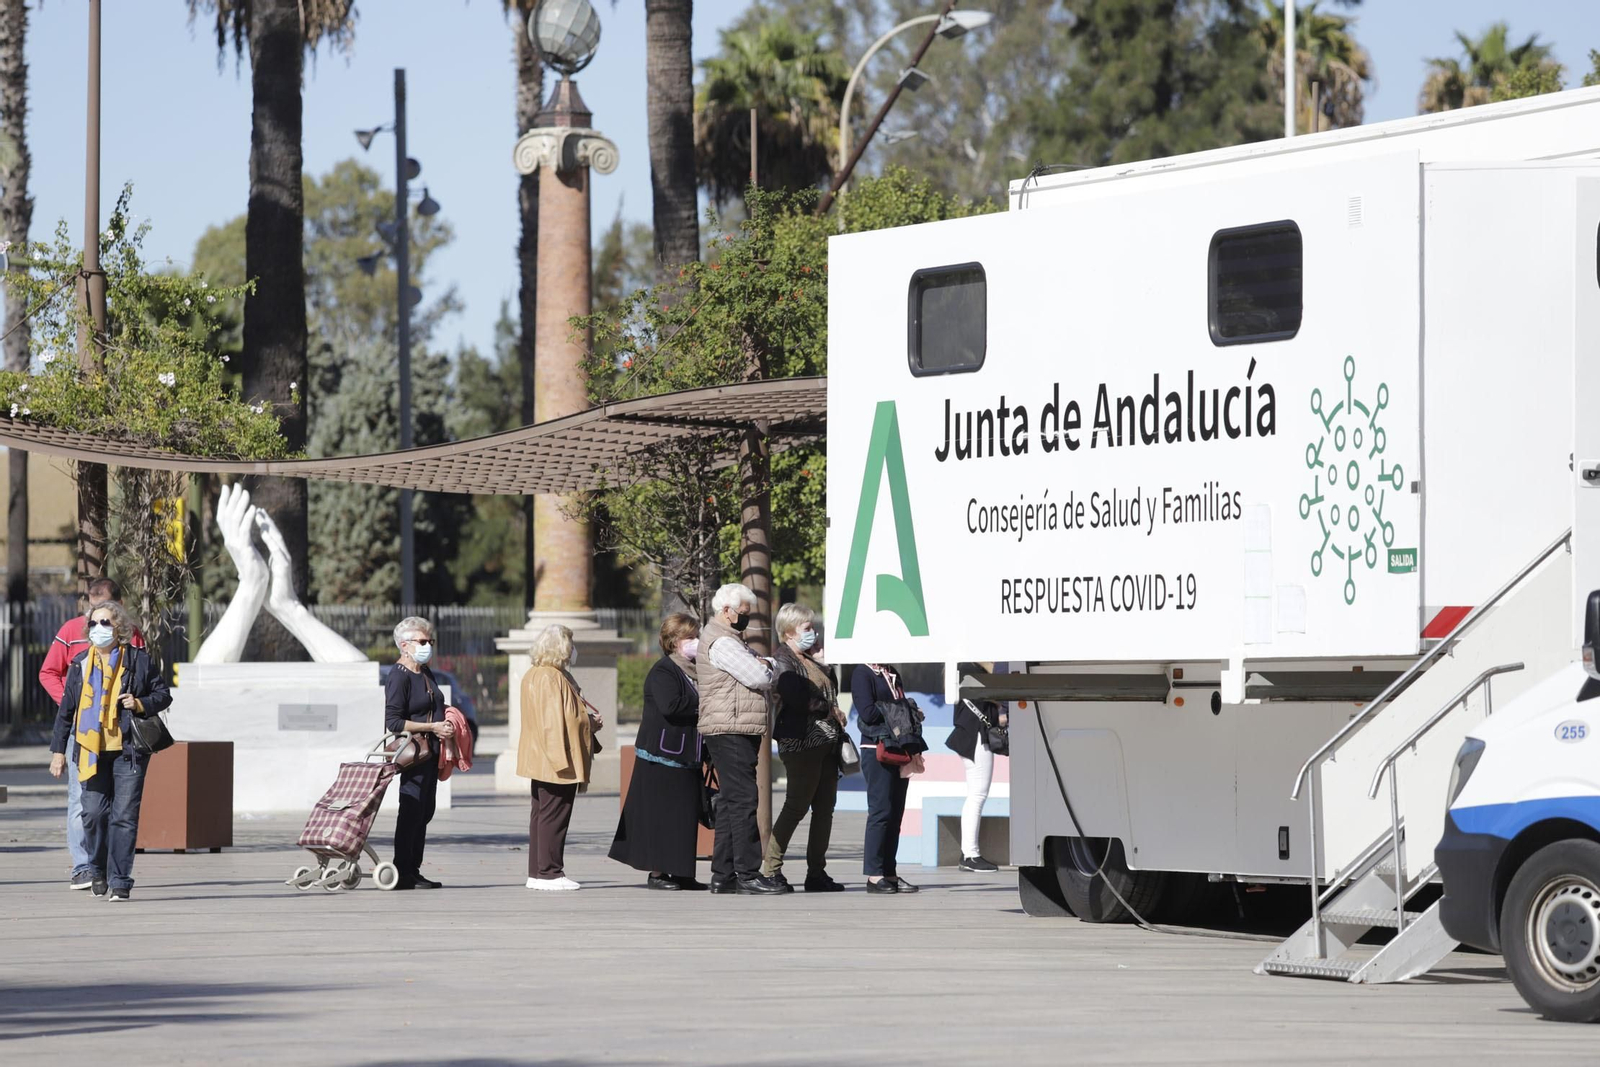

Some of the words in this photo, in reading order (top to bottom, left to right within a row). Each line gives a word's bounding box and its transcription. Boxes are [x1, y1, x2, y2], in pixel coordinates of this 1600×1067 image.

[934, 395, 1029, 463] Junta
[1040, 382, 1082, 454] de
[1090, 356, 1277, 449] Andalucía
[966, 488, 1059, 543] Consejería
[1063, 490, 1086, 530] de
[1090, 486, 1142, 529] Salud
[1146, 496, 1157, 536] y
[1162, 481, 1242, 524] Familias
[1390, 553, 1414, 567] SALIDA
[1001, 576, 1105, 615] RESPUESTA
[1110, 573, 1197, 612] COVID-19
[1561, 725, 1586, 740] 255
